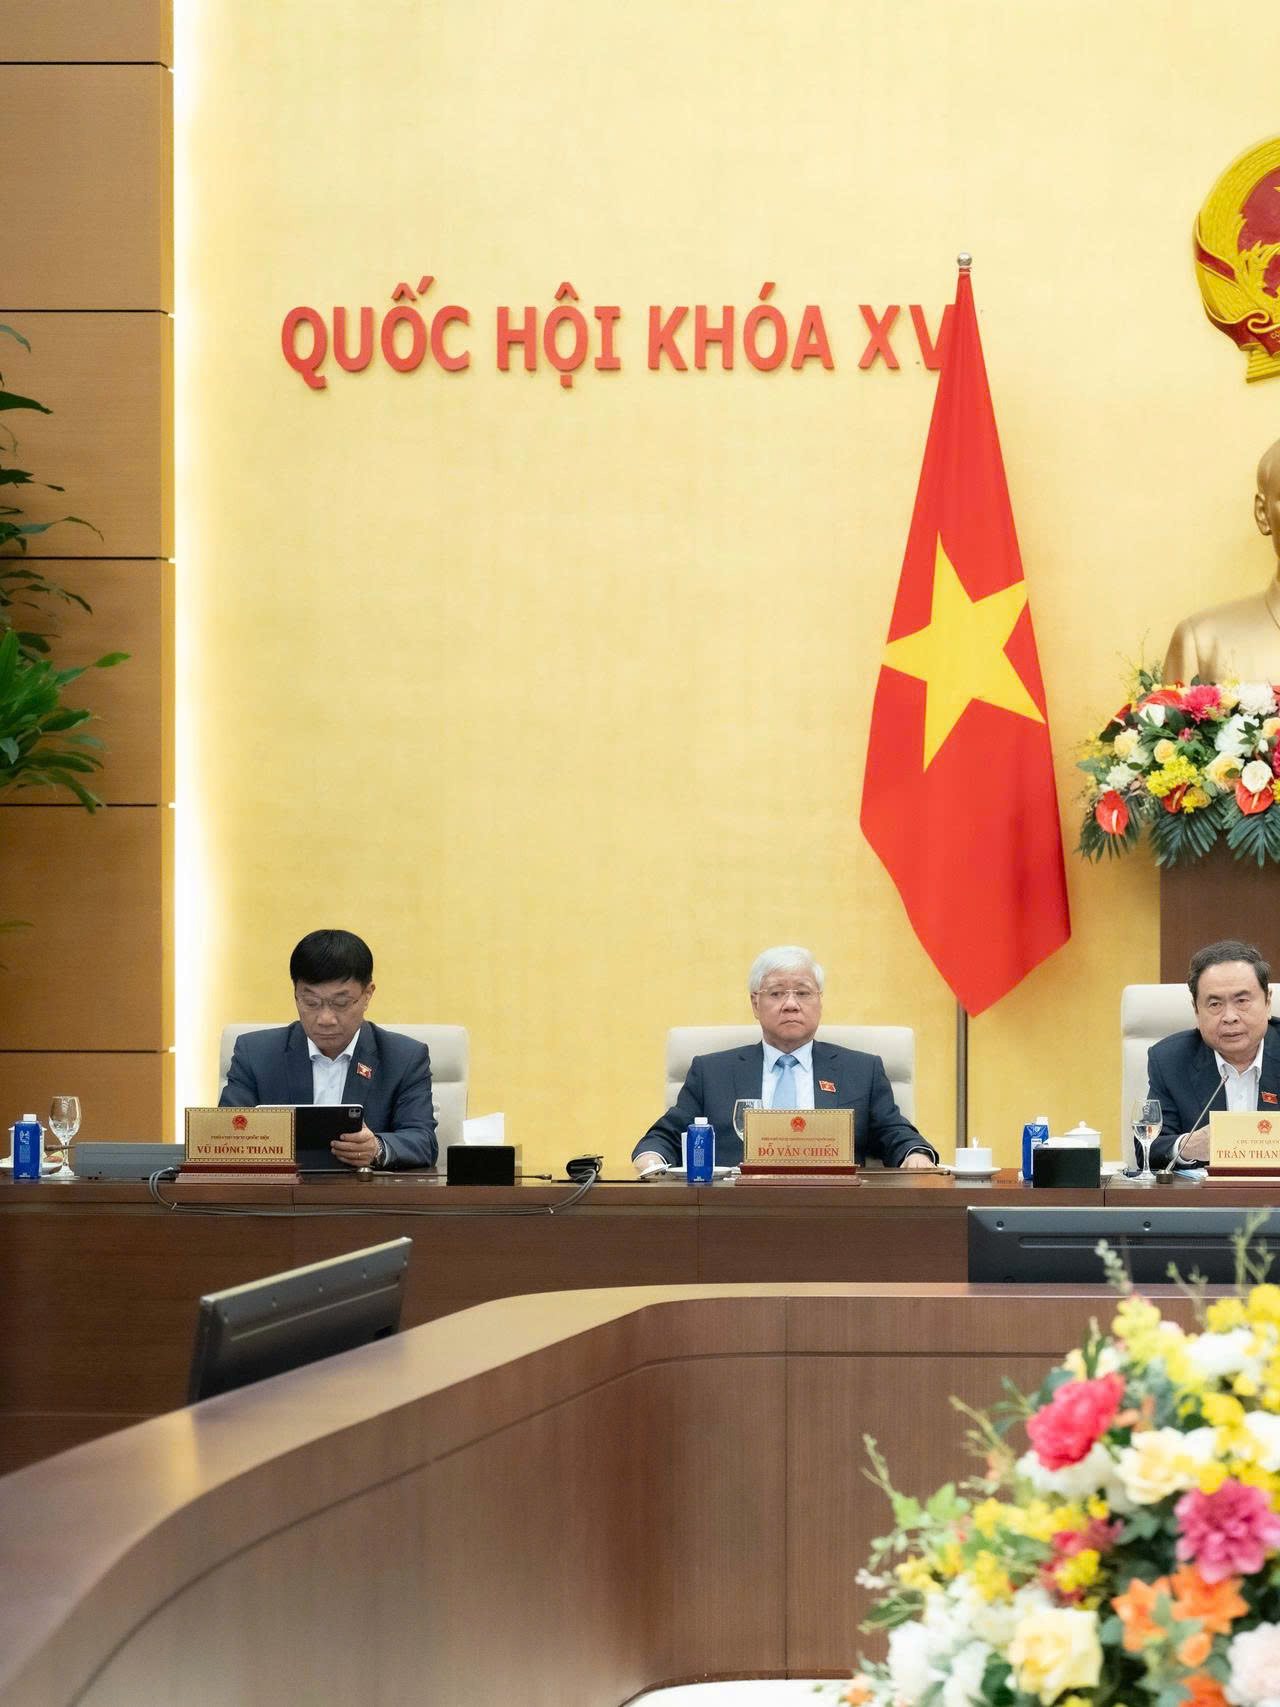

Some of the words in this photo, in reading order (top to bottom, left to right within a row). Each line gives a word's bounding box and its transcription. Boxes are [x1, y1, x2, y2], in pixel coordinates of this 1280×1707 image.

[281, 275, 470, 388] QUỐC
[497, 281, 621, 388] HỘI
[648, 281, 836, 371] KHÓA
[858, 304, 956, 371] XV
[246, 1145, 284, 1154] THANH
[758, 1142, 775, 1157] ĐỖ
[777, 1144, 801, 1157] VĂN
